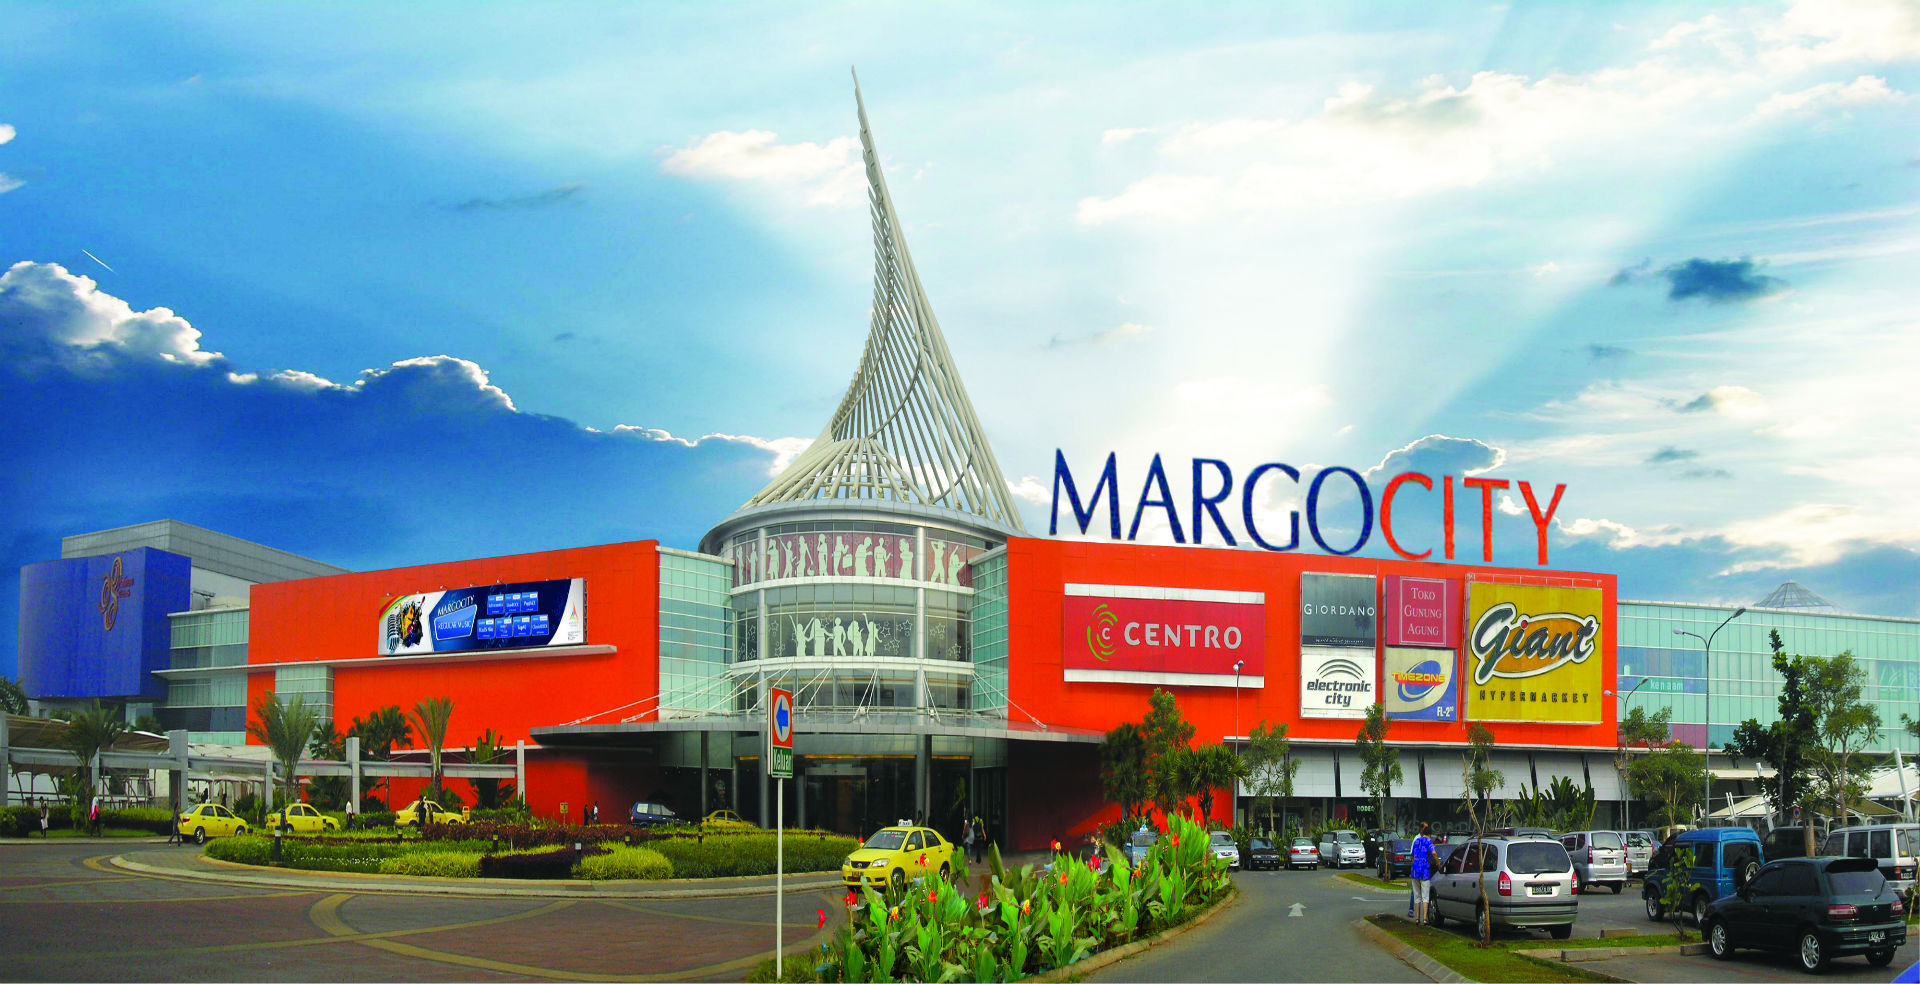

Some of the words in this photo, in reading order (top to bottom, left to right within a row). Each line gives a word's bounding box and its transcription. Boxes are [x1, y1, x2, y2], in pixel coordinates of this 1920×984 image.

[437, 594, 475, 616] MARGOCITY
[1303, 603, 1375, 617] GIORDANO
[1124, 621, 1243, 650] CENTRO
[1473, 604, 1598, 683] Giant
[1391, 671, 1446, 684] TIMEZONE
[1306, 678, 1372, 693] electronic
[1324, 692, 1352, 708] city
[1479, 689, 1589, 704] HYPERMARKET
